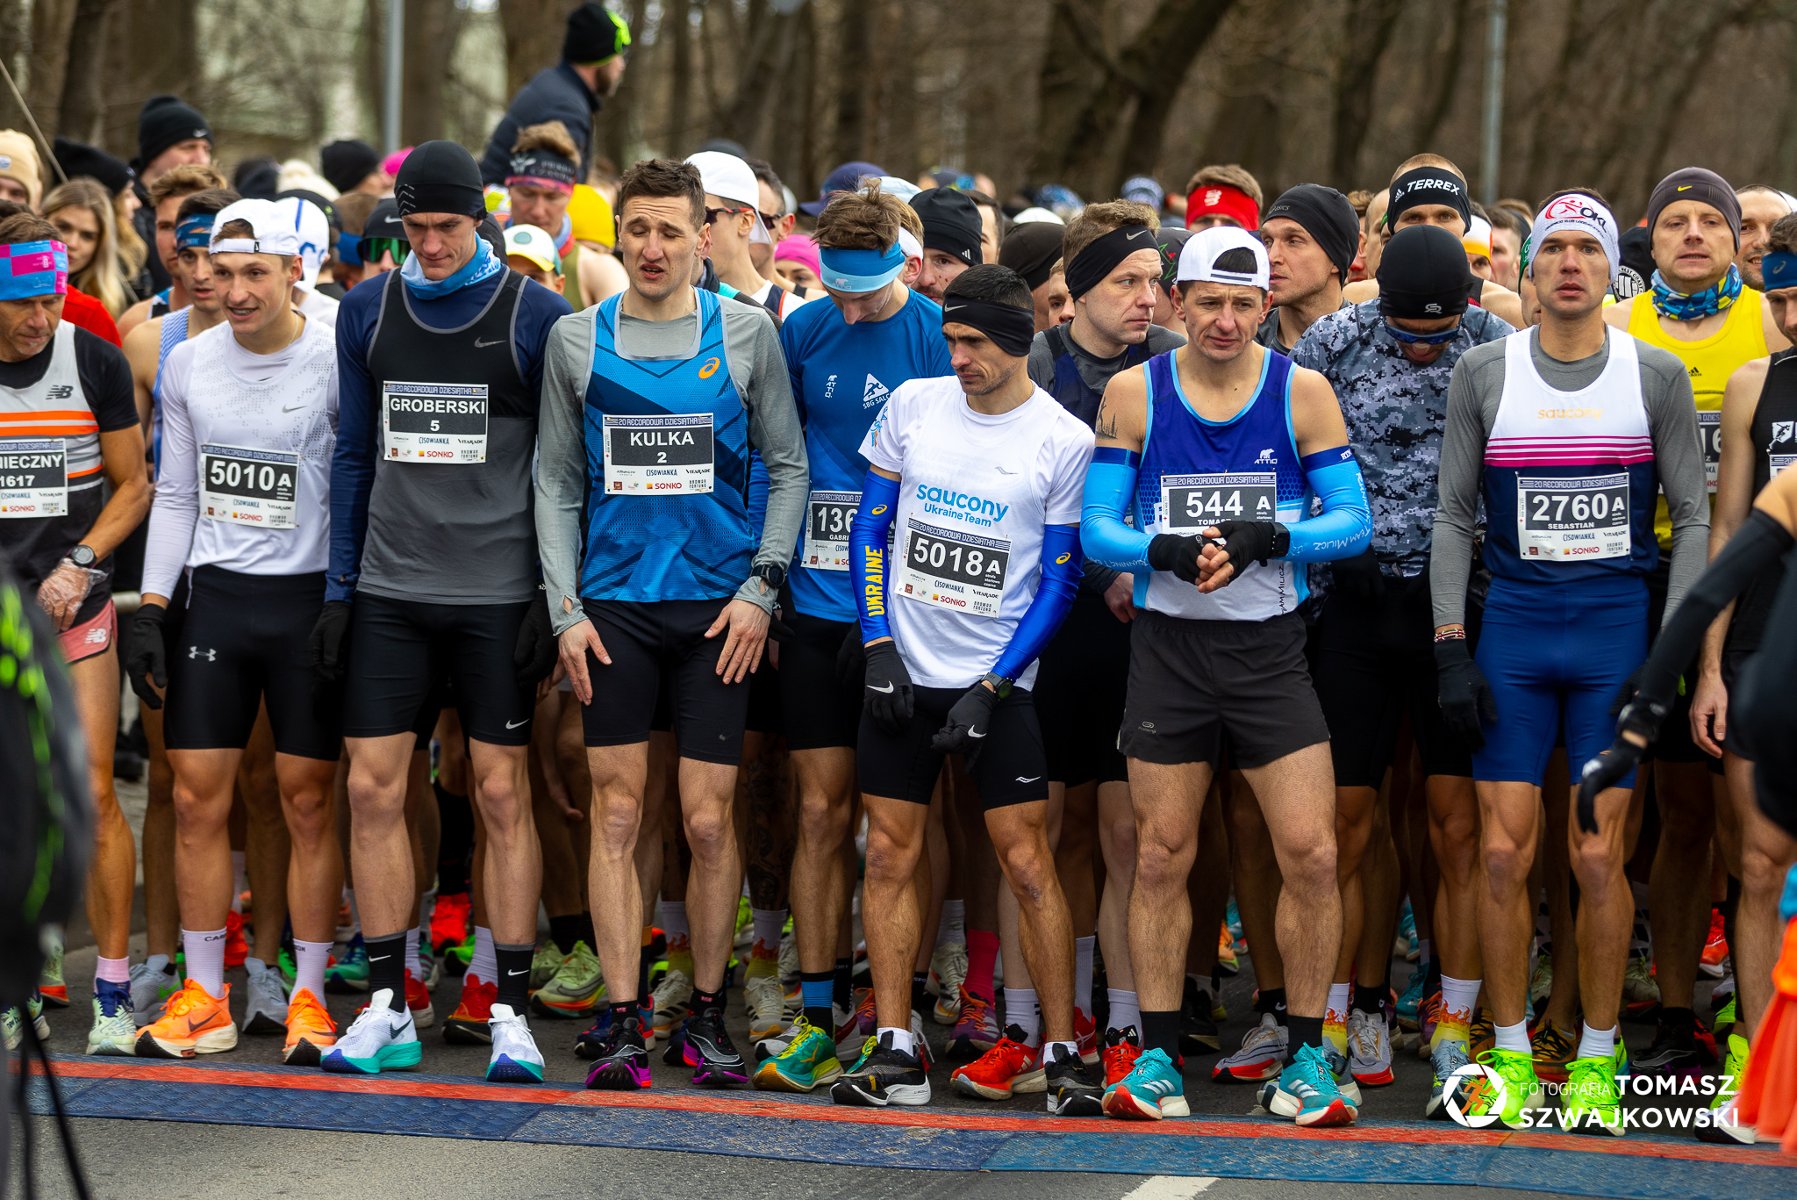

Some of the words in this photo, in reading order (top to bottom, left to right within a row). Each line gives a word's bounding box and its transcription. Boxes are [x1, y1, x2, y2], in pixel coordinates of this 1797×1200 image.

[1407, 179, 1460, 195] TERREX
[403, 386, 438, 394] RECORDOWA
[390, 398, 485, 414] GROBERSKI
[430, 420, 440, 432] 5
[618, 418, 627, 426] 20
[627, 419, 664, 427] RECORDOWA
[665, 417, 698, 426] DZIESIĄTKA
[419, 436, 449, 445] CISOWIANKA
[630, 430, 695, 447] KULKA
[427, 450, 453, 458] SONKO
[657, 451, 668, 464] 2
[210, 460, 275, 491] 5010
[277, 473, 292, 487] A
[646, 469, 678, 477] CISOWIANKA
[655, 482, 682, 490] SONKO
[1186, 477, 1225, 485] RECORDOWA
[1226, 475, 1260, 485] DZIESIĄTKA
[1543, 480, 1581, 488] RECORDOWA
[1582, 478, 1615, 488] DZIESIĄTKA
[916, 484, 1009, 522] saucony
[1186, 491, 1244, 517] 544
[1256, 496, 1271, 510] A
[1532, 493, 1608, 521] 2760
[1612, 497, 1625, 511] A
[240, 513, 263, 521] SONKO
[924, 503, 963, 520] Ukraine
[964, 512, 992, 528] Team
[1198, 518, 1231, 526] TOMA
[1548, 522, 1595, 530] SEBASTIAN
[920, 524, 927, 532] 20
[926, 526, 962, 541] RECORDOWA
[962, 533, 995, 549] DZIESIĄTKA
[1563, 533, 1595, 542] CISOWIANKA
[1313, 537, 1350, 551] MILICZ
[1572, 546, 1600, 555] SONKO
[914, 537, 984, 577] 5018
[986, 560, 1001, 575] A
[865, 546, 885, 617] UKRAINE
[934, 579, 965, 594] CISOWIANKA
[941, 595, 967, 607] SONKO
